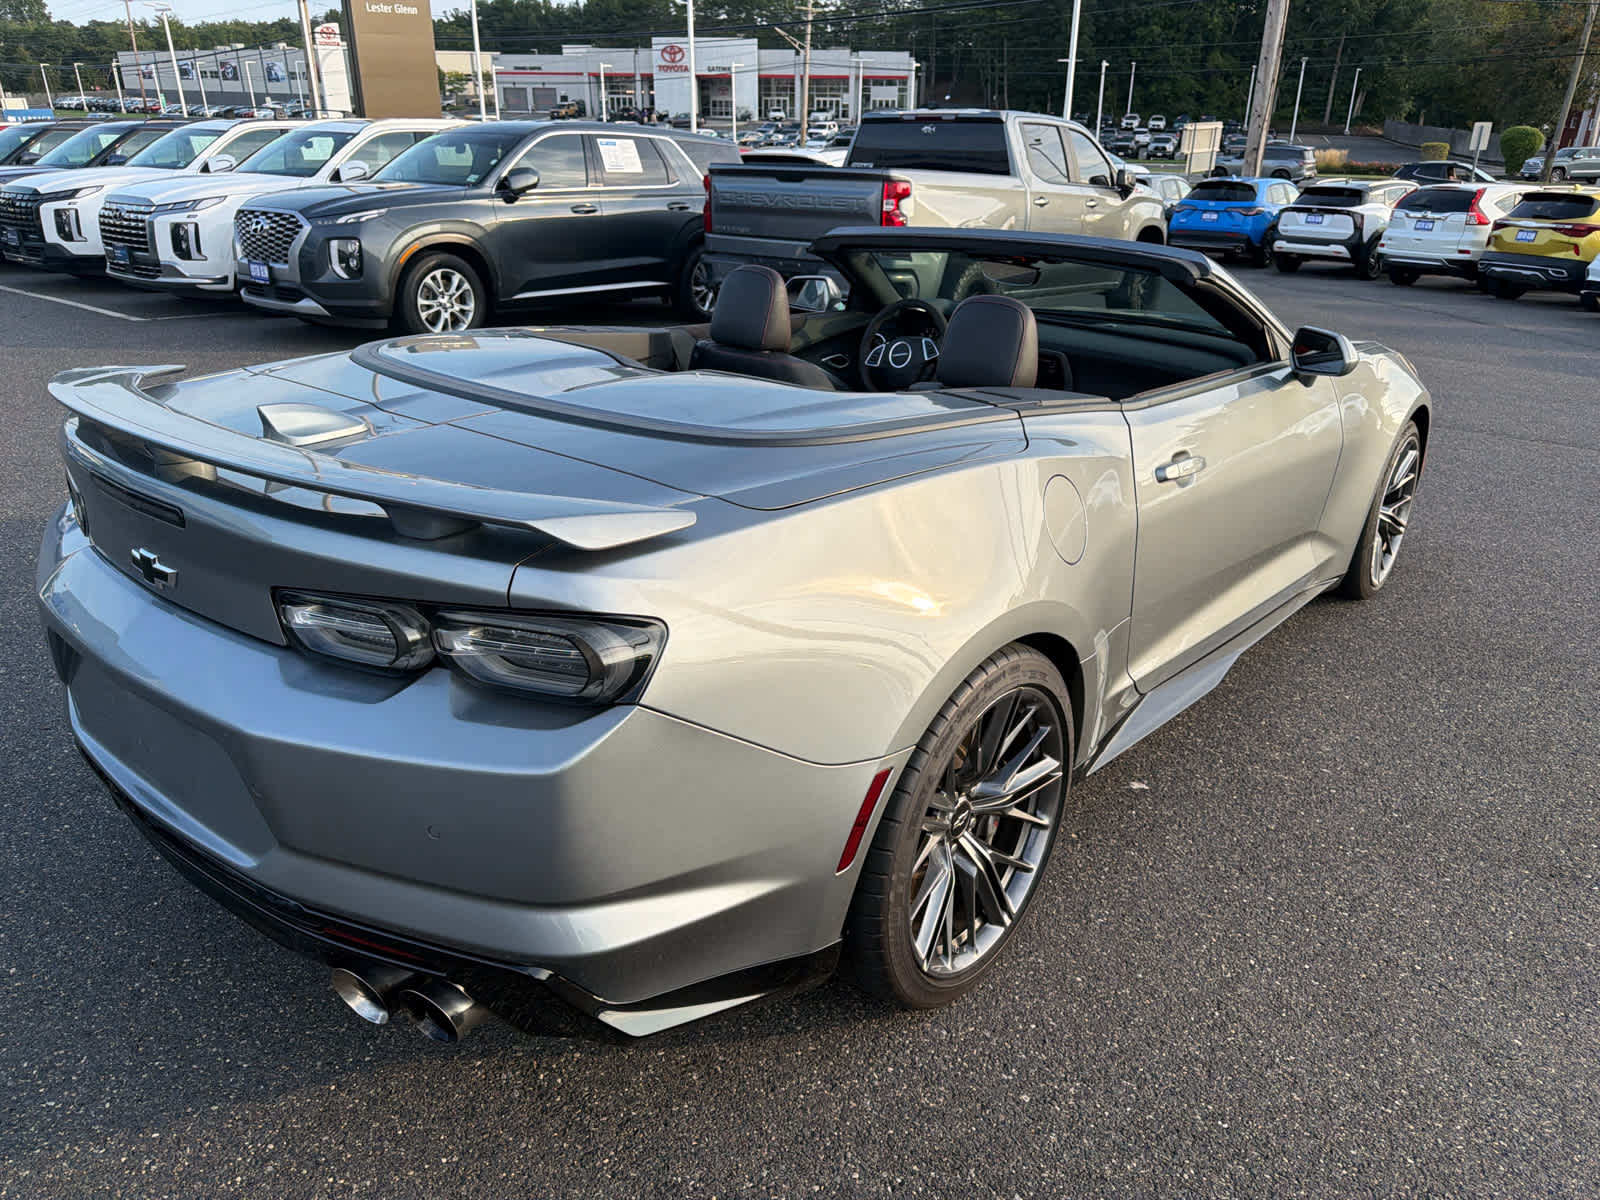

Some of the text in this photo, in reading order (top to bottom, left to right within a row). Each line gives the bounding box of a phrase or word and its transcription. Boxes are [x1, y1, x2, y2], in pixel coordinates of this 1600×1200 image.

[365, 1, 418, 15] Lester Glenn
[658, 64, 689, 72] TOYOTA
[719, 191, 869, 211] CHEVROLET
